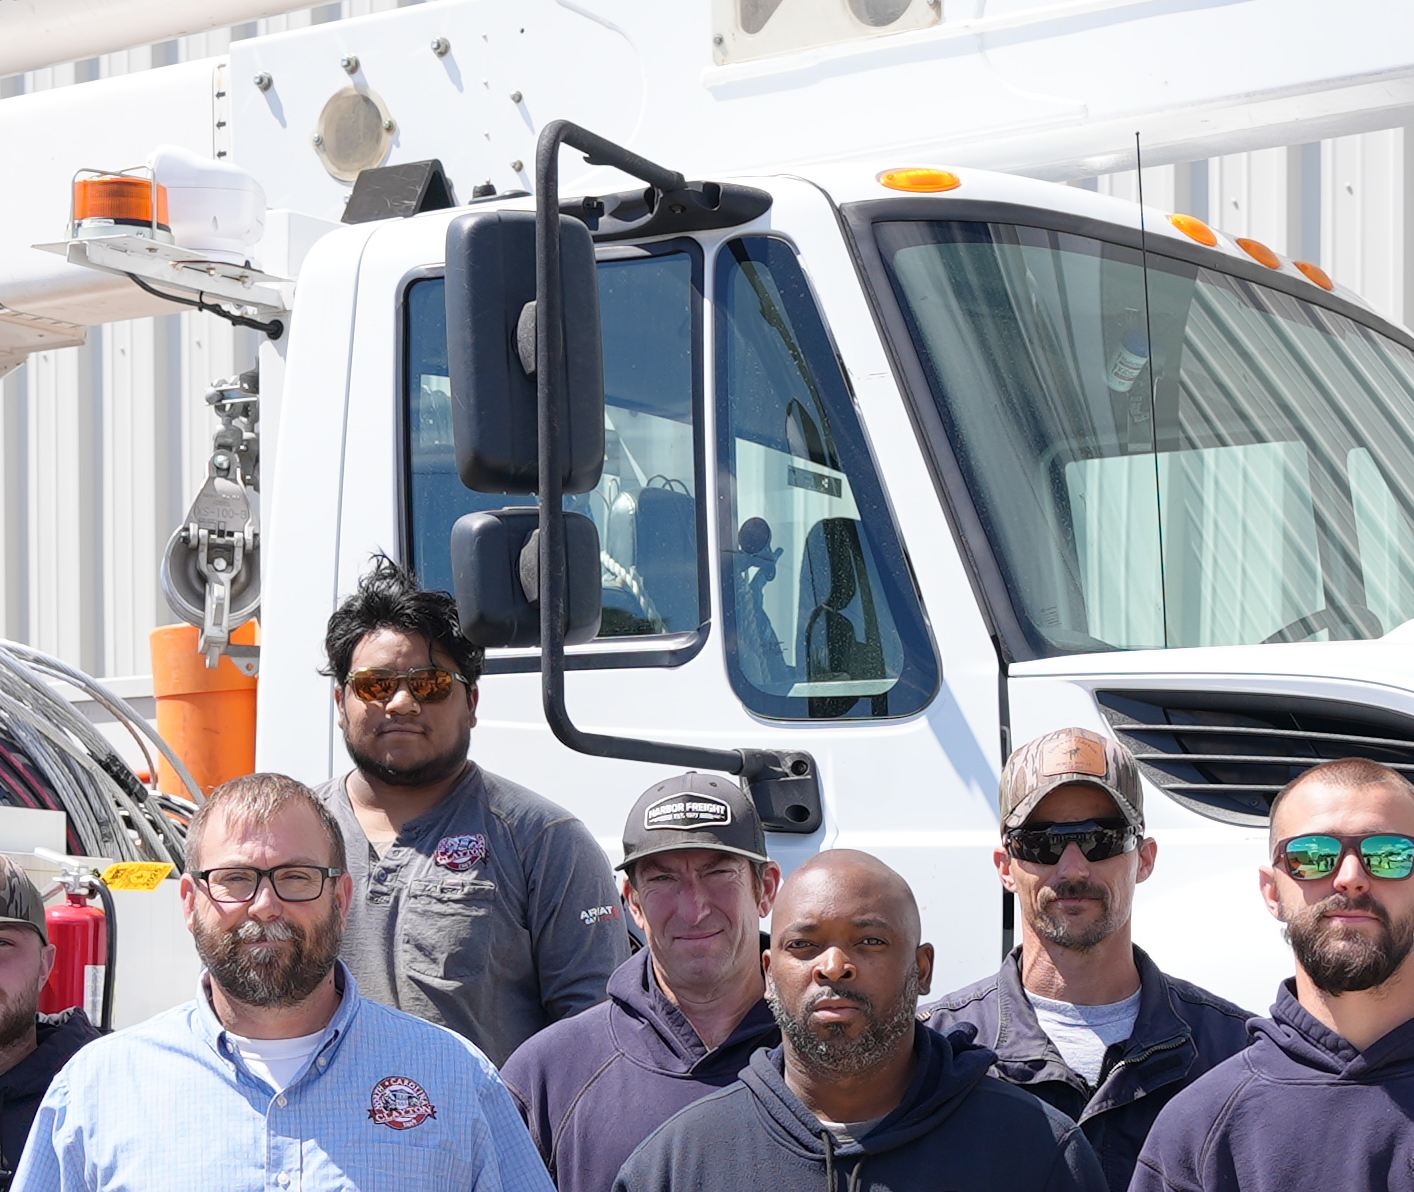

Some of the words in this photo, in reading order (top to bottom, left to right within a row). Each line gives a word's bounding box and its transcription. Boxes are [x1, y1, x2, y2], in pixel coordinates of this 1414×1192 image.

[648, 803, 685, 818] HARBOR
[685, 802, 726, 815] FREIGHT
[437, 849, 486, 864] CLAYTON
[580, 905, 613, 920] ARIAT
[375, 1105, 432, 1121] CLAYTON
